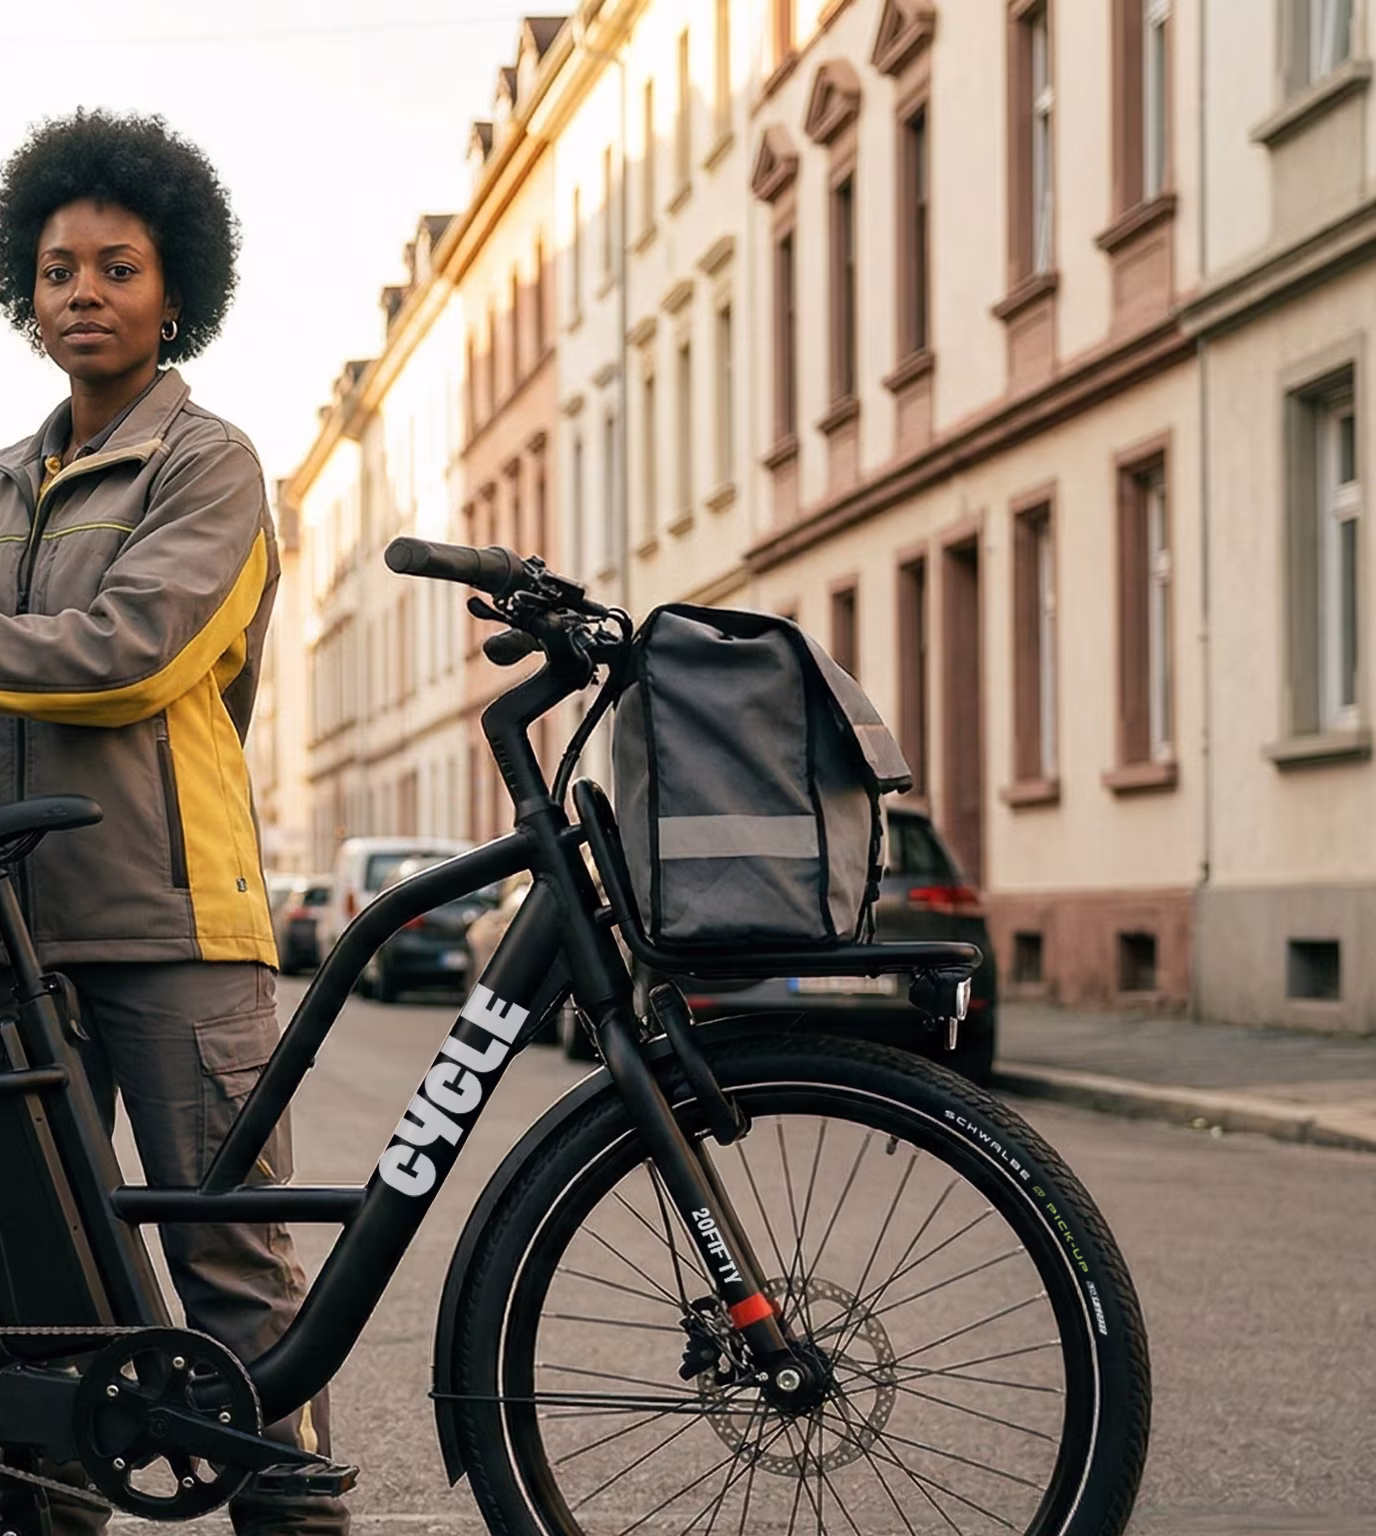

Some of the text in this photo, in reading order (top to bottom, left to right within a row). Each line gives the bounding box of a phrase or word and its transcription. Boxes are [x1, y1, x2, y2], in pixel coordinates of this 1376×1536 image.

[379, 984, 530, 1197] CYCLE
[691, 1207, 742, 1283] 20FIFTY
[945, 1110, 1088, 1272] SCHWALBE PICK-UP
